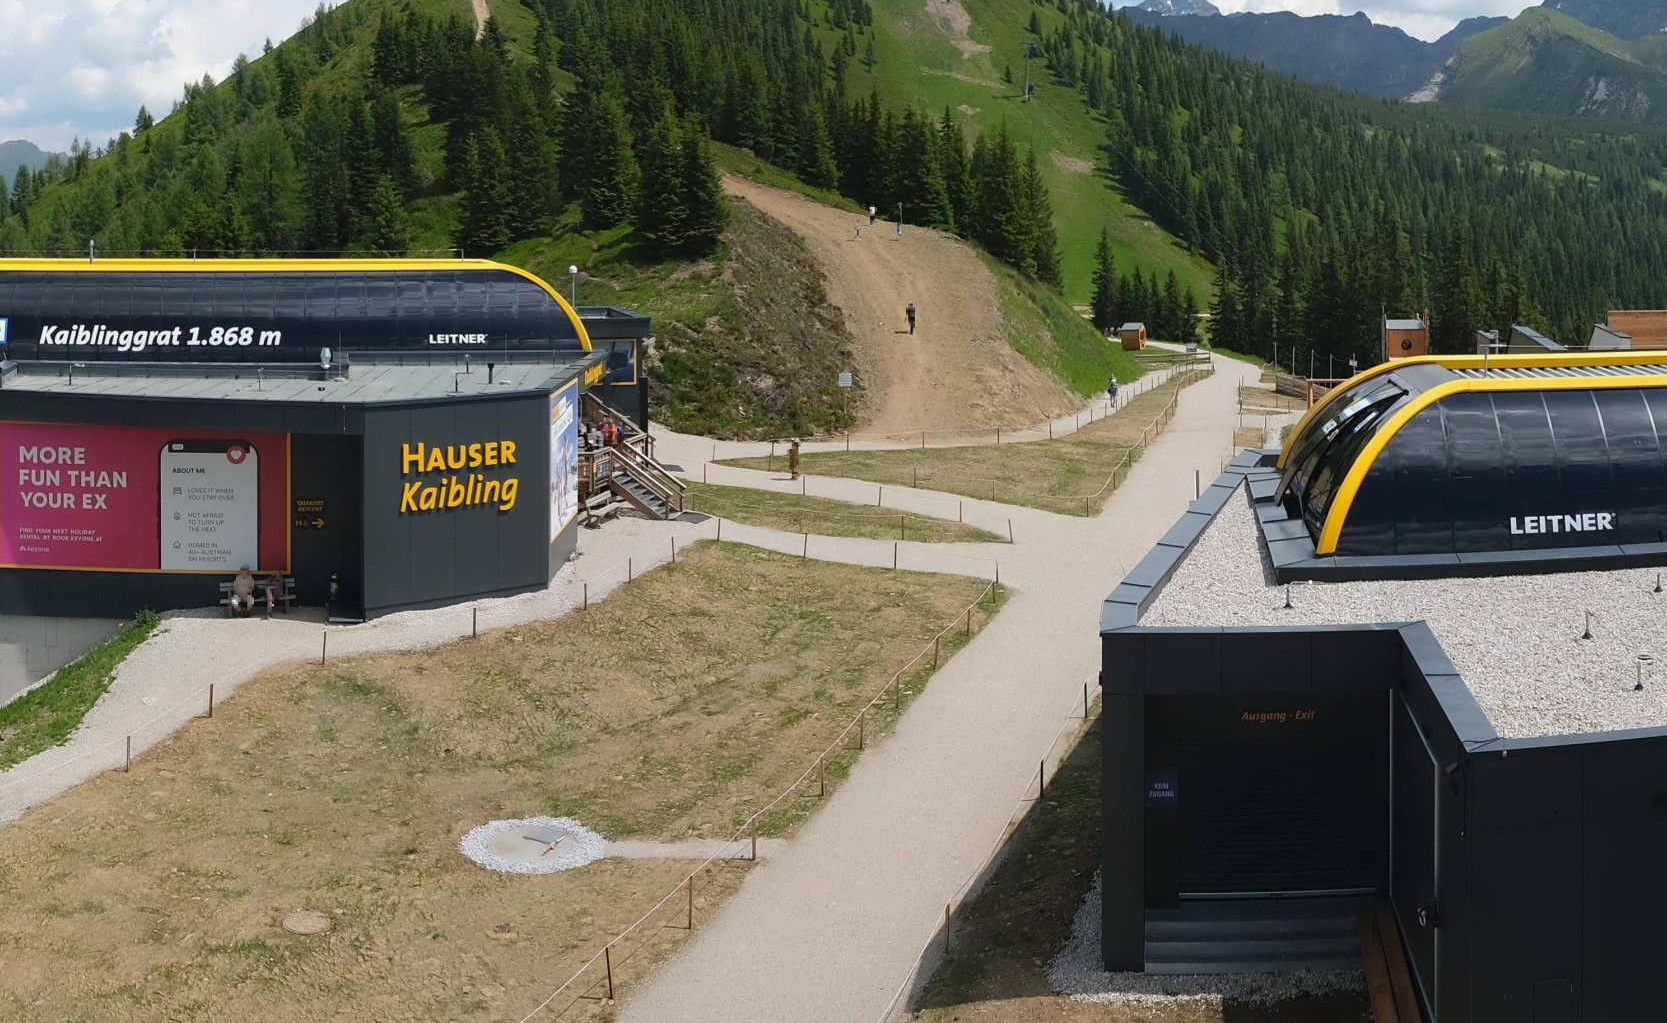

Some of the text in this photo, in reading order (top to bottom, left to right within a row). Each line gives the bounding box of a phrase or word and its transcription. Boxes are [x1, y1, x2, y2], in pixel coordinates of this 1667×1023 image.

[39, 324, 281, 352] Kaiblinggrat 1.868 m
[429, 334, 486, 344] LEITNER
[19, 446, 86, 465] MORE
[402, 440, 517, 474] HAUSER
[19, 469, 127, 488] FUN THAN
[20, 491, 108, 510] YOUR EX
[400, 474, 519, 513] Kaibling
[1510, 513, 1614, 534] LEITNER
[1241, 711, 1286, 723] Ausgang
[1295, 709, 1315, 720] Exit
[1149, 790, 1174, 798] ZUGANG
